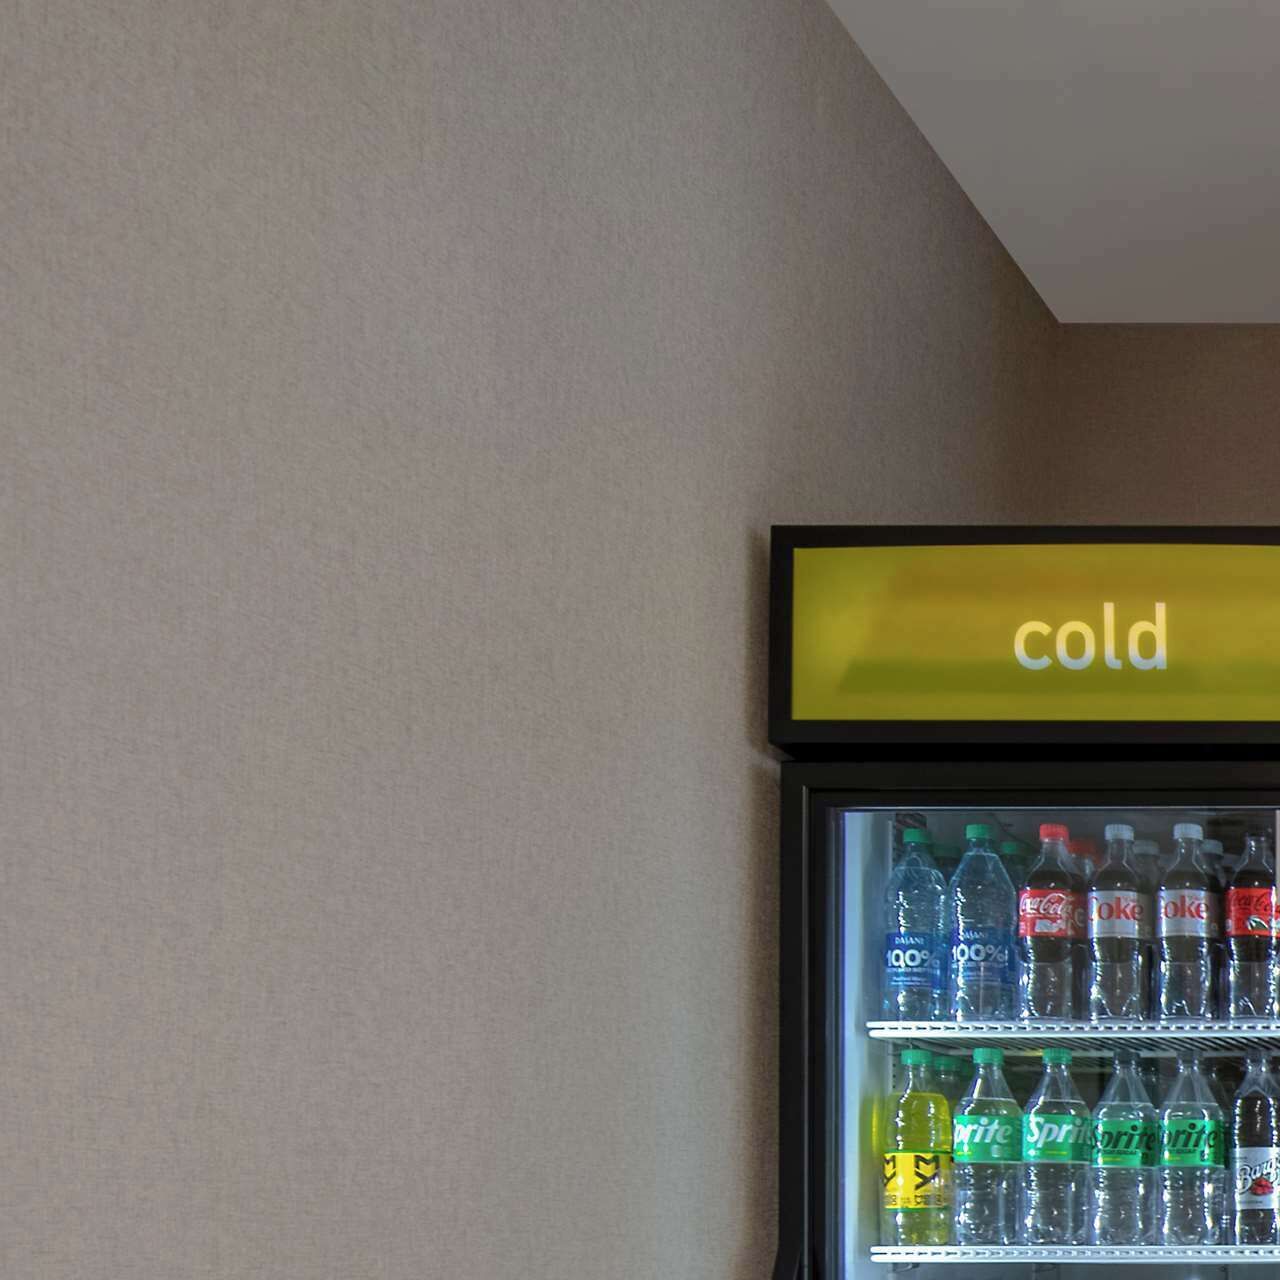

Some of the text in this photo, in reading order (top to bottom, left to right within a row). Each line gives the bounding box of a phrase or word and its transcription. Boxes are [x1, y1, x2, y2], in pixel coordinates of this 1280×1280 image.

[1014, 602, 1167, 671] cold
[954, 1117, 1012, 1149] prite
[1027, 1116, 1090, 1148] Sprit
